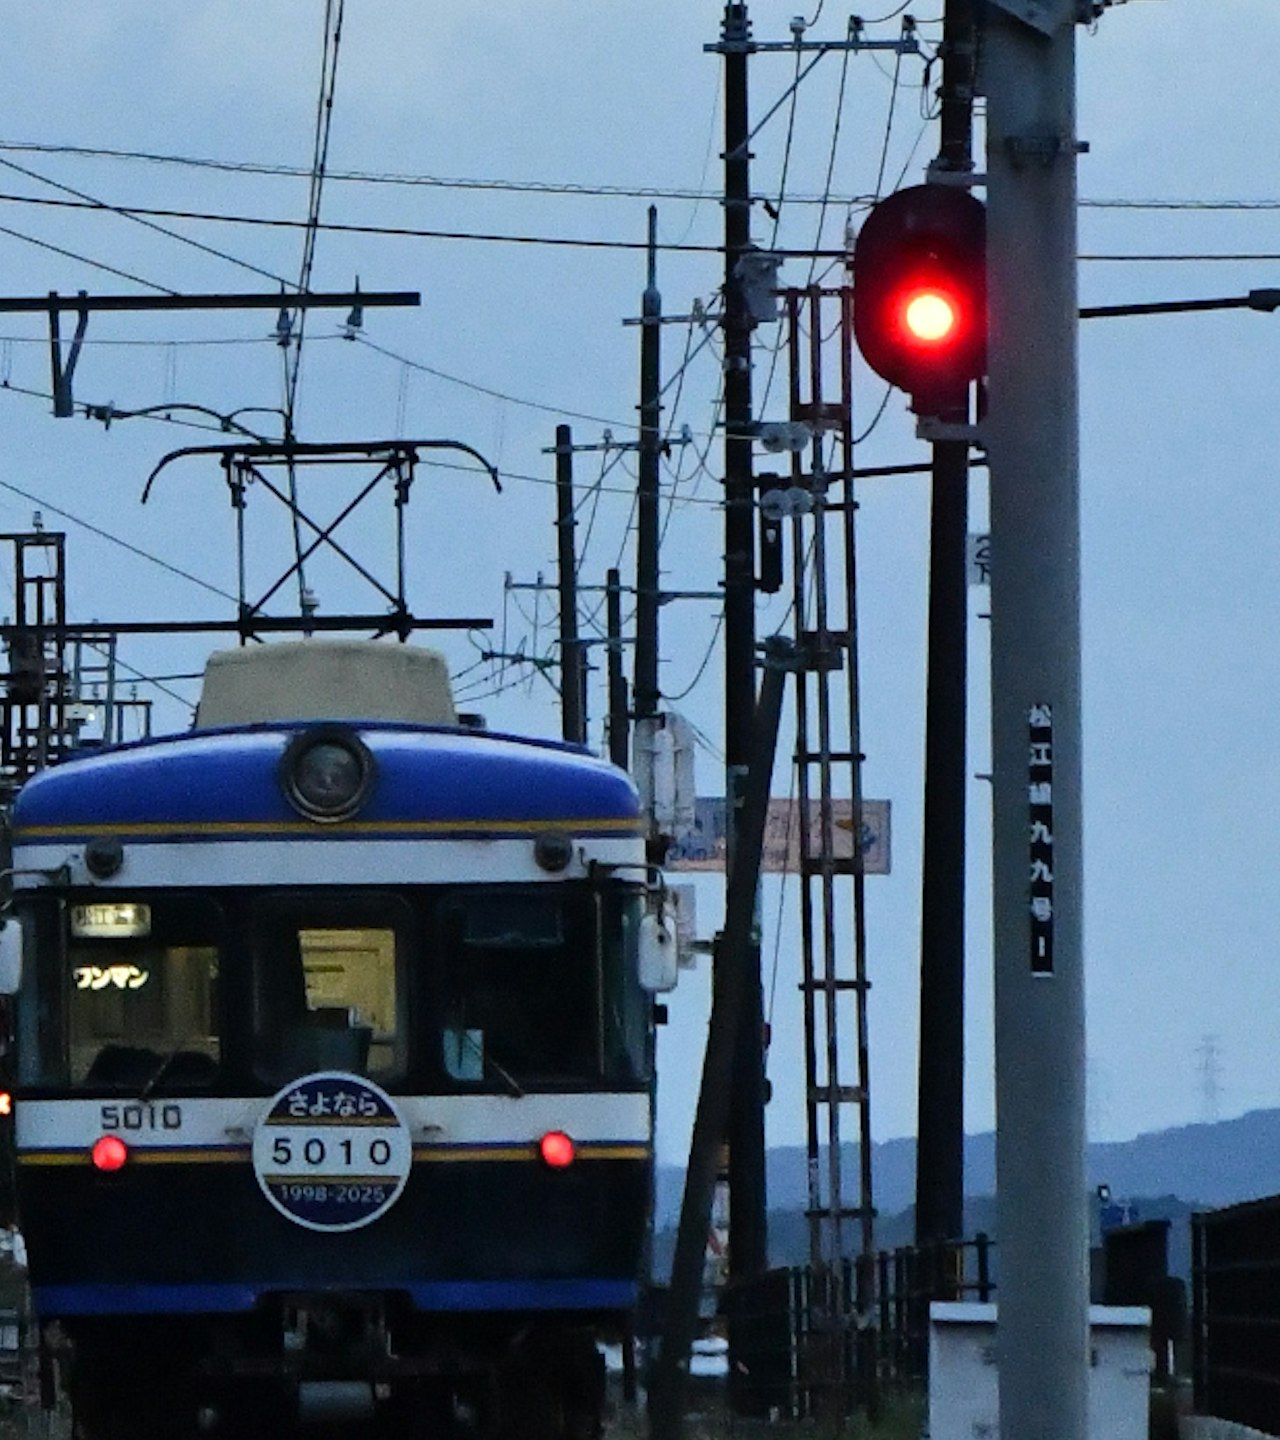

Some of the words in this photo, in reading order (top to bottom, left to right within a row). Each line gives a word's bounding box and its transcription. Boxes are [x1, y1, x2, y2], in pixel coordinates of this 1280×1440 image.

[73, 965, 149, 990] ワンマン
[288, 1091, 380, 1116] さよなら
[101, 1105, 182, 1130] 5010
[271, 1138, 392, 1165] 5010
[280, 1184, 386, 1203] 1998-2025
